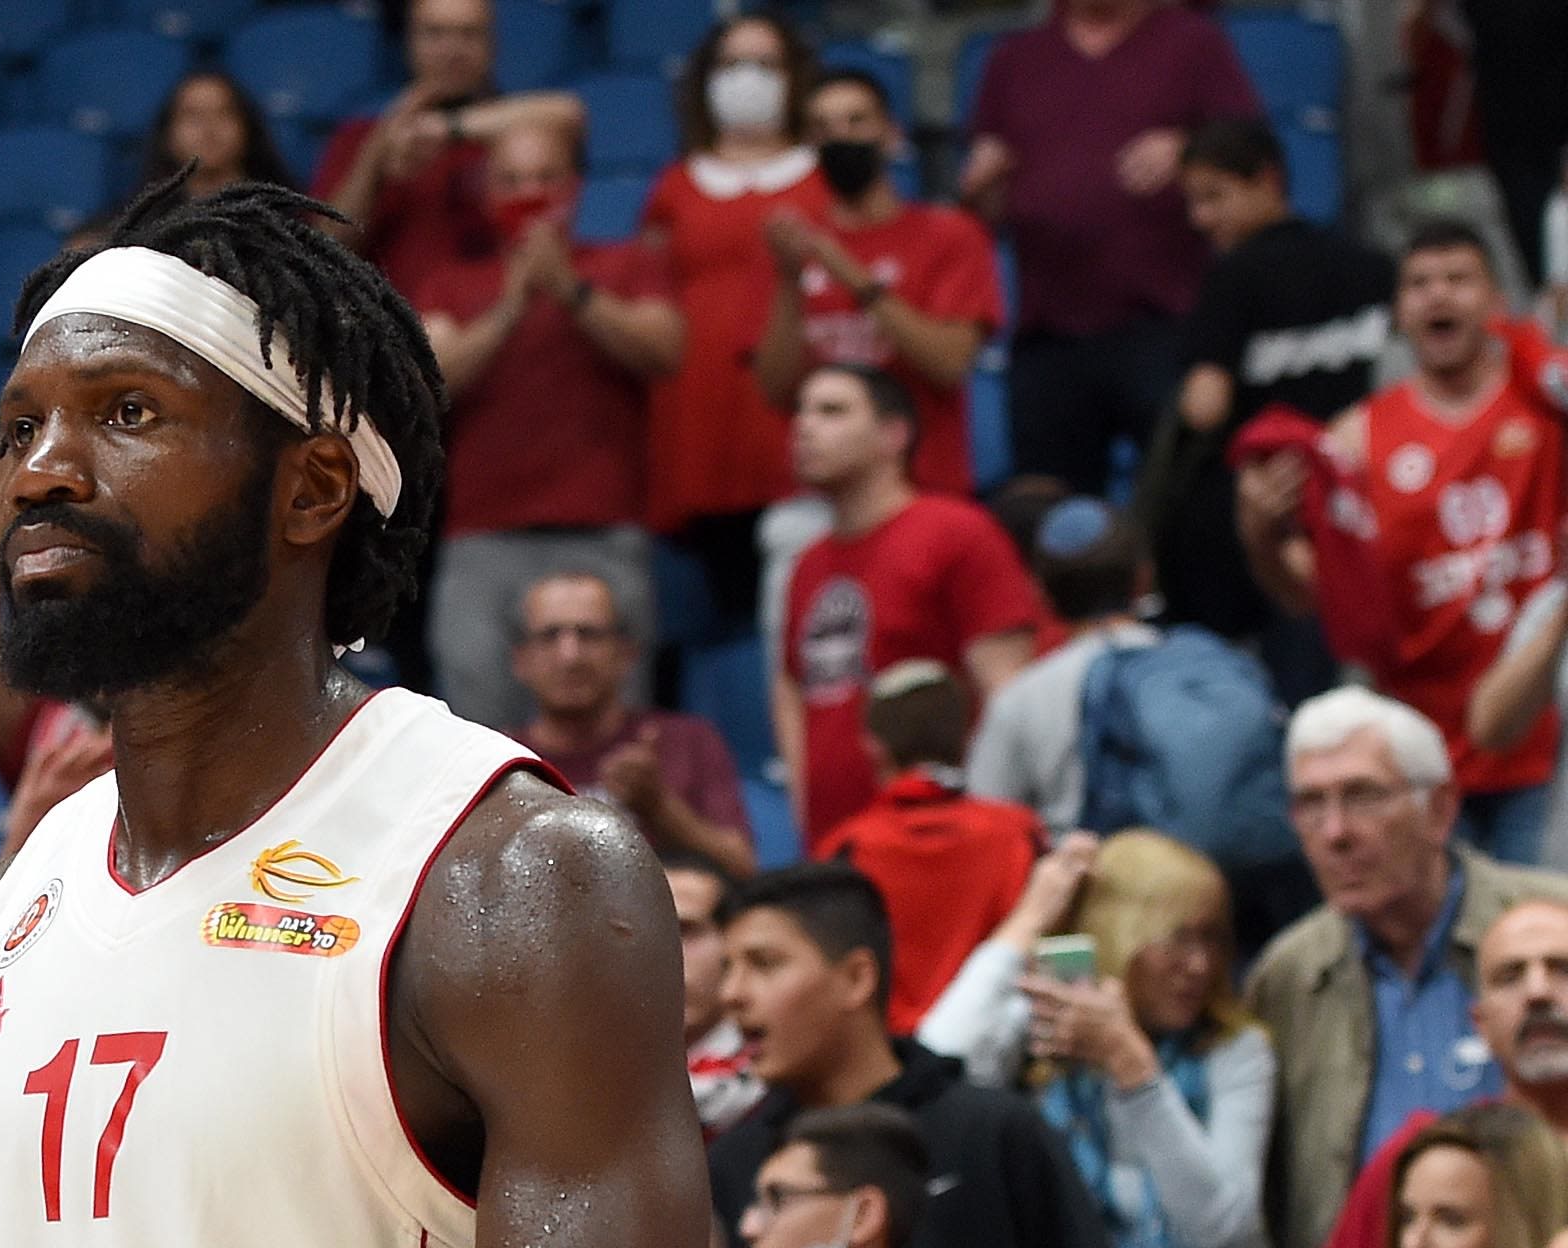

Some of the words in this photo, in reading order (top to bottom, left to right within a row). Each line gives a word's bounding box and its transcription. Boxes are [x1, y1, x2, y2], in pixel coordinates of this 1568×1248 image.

[217, 913, 312, 947] Winner
[277, 916, 316, 933] ליגת
[311, 930, 336, 949] סל
[23, 1031, 169, 1223] 17
